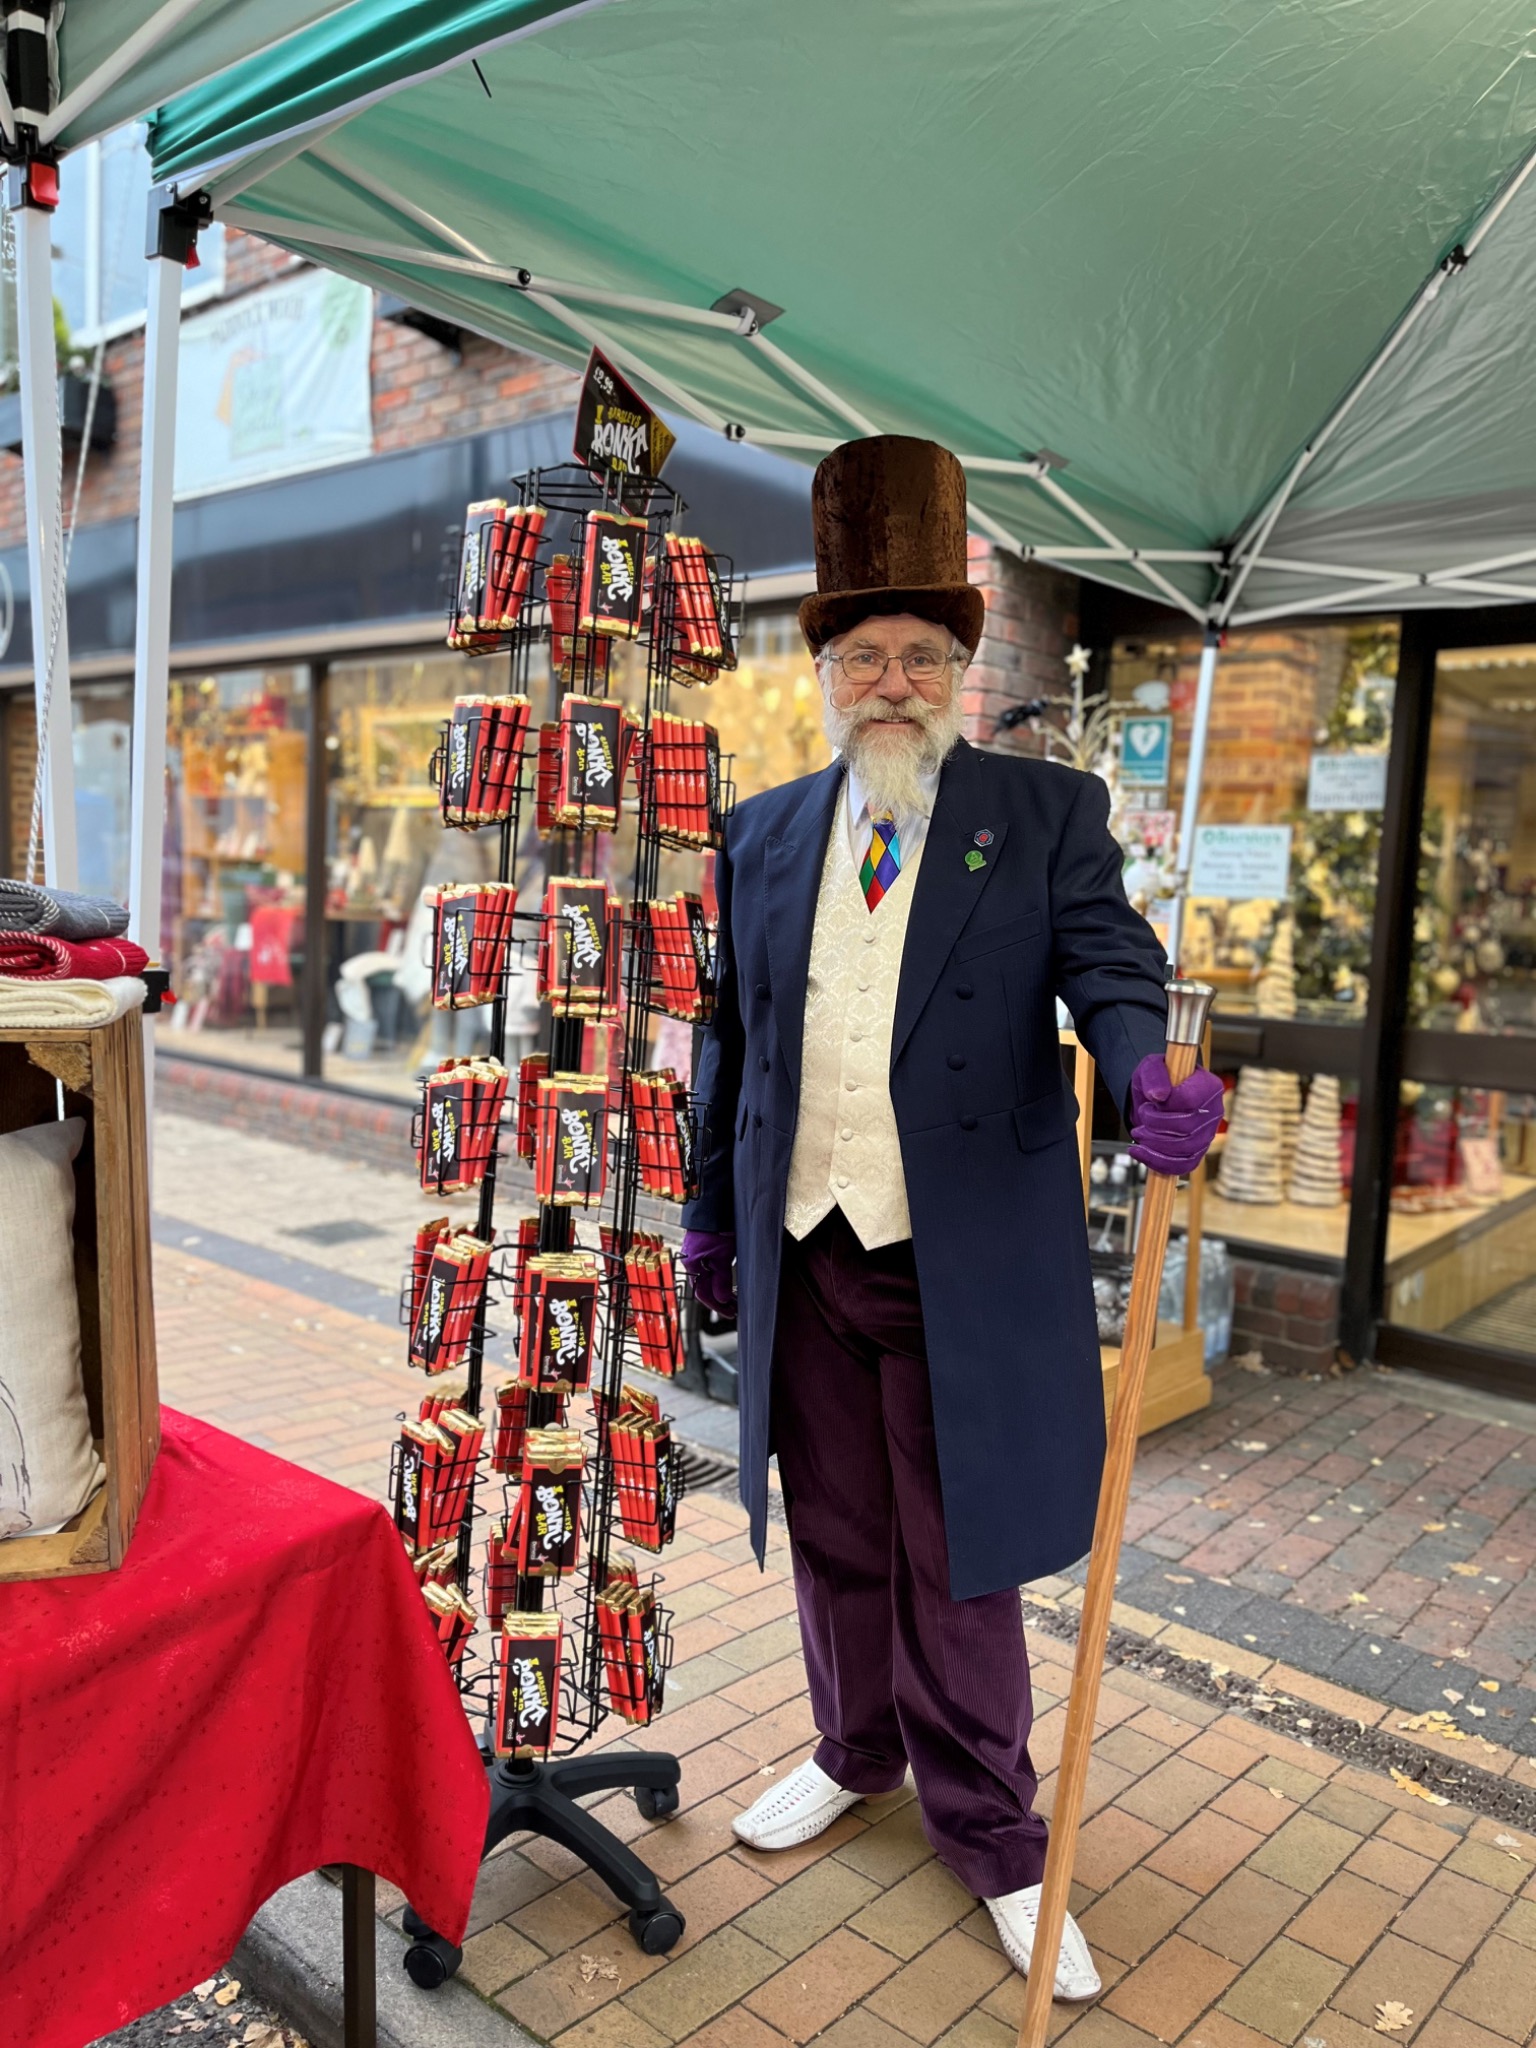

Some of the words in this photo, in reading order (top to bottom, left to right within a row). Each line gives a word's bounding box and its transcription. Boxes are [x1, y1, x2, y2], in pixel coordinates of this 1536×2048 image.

[591, 422, 649, 475] BONKA
[600, 562, 612, 584] BAR
[601, 536, 633, 602] BONKA
[575, 722, 613, 788] BONKA
[444, 917, 468, 978] BONKA
[561, 904, 601, 968] BONKA
[432, 1129, 440, 1151] BAR
[561, 1108, 597, 1174] BONKA
[562, 1136, 574, 1159] BAR
[585, 1122, 598, 1156] BAREYS
[549, 1298, 585, 1365] BONKA
[549, 1327, 561, 1350] BAR
[535, 1485, 572, 1550] BONKA
[536, 1512, 547, 1536] BAR
[512, 1658, 548, 1728] BONKA
